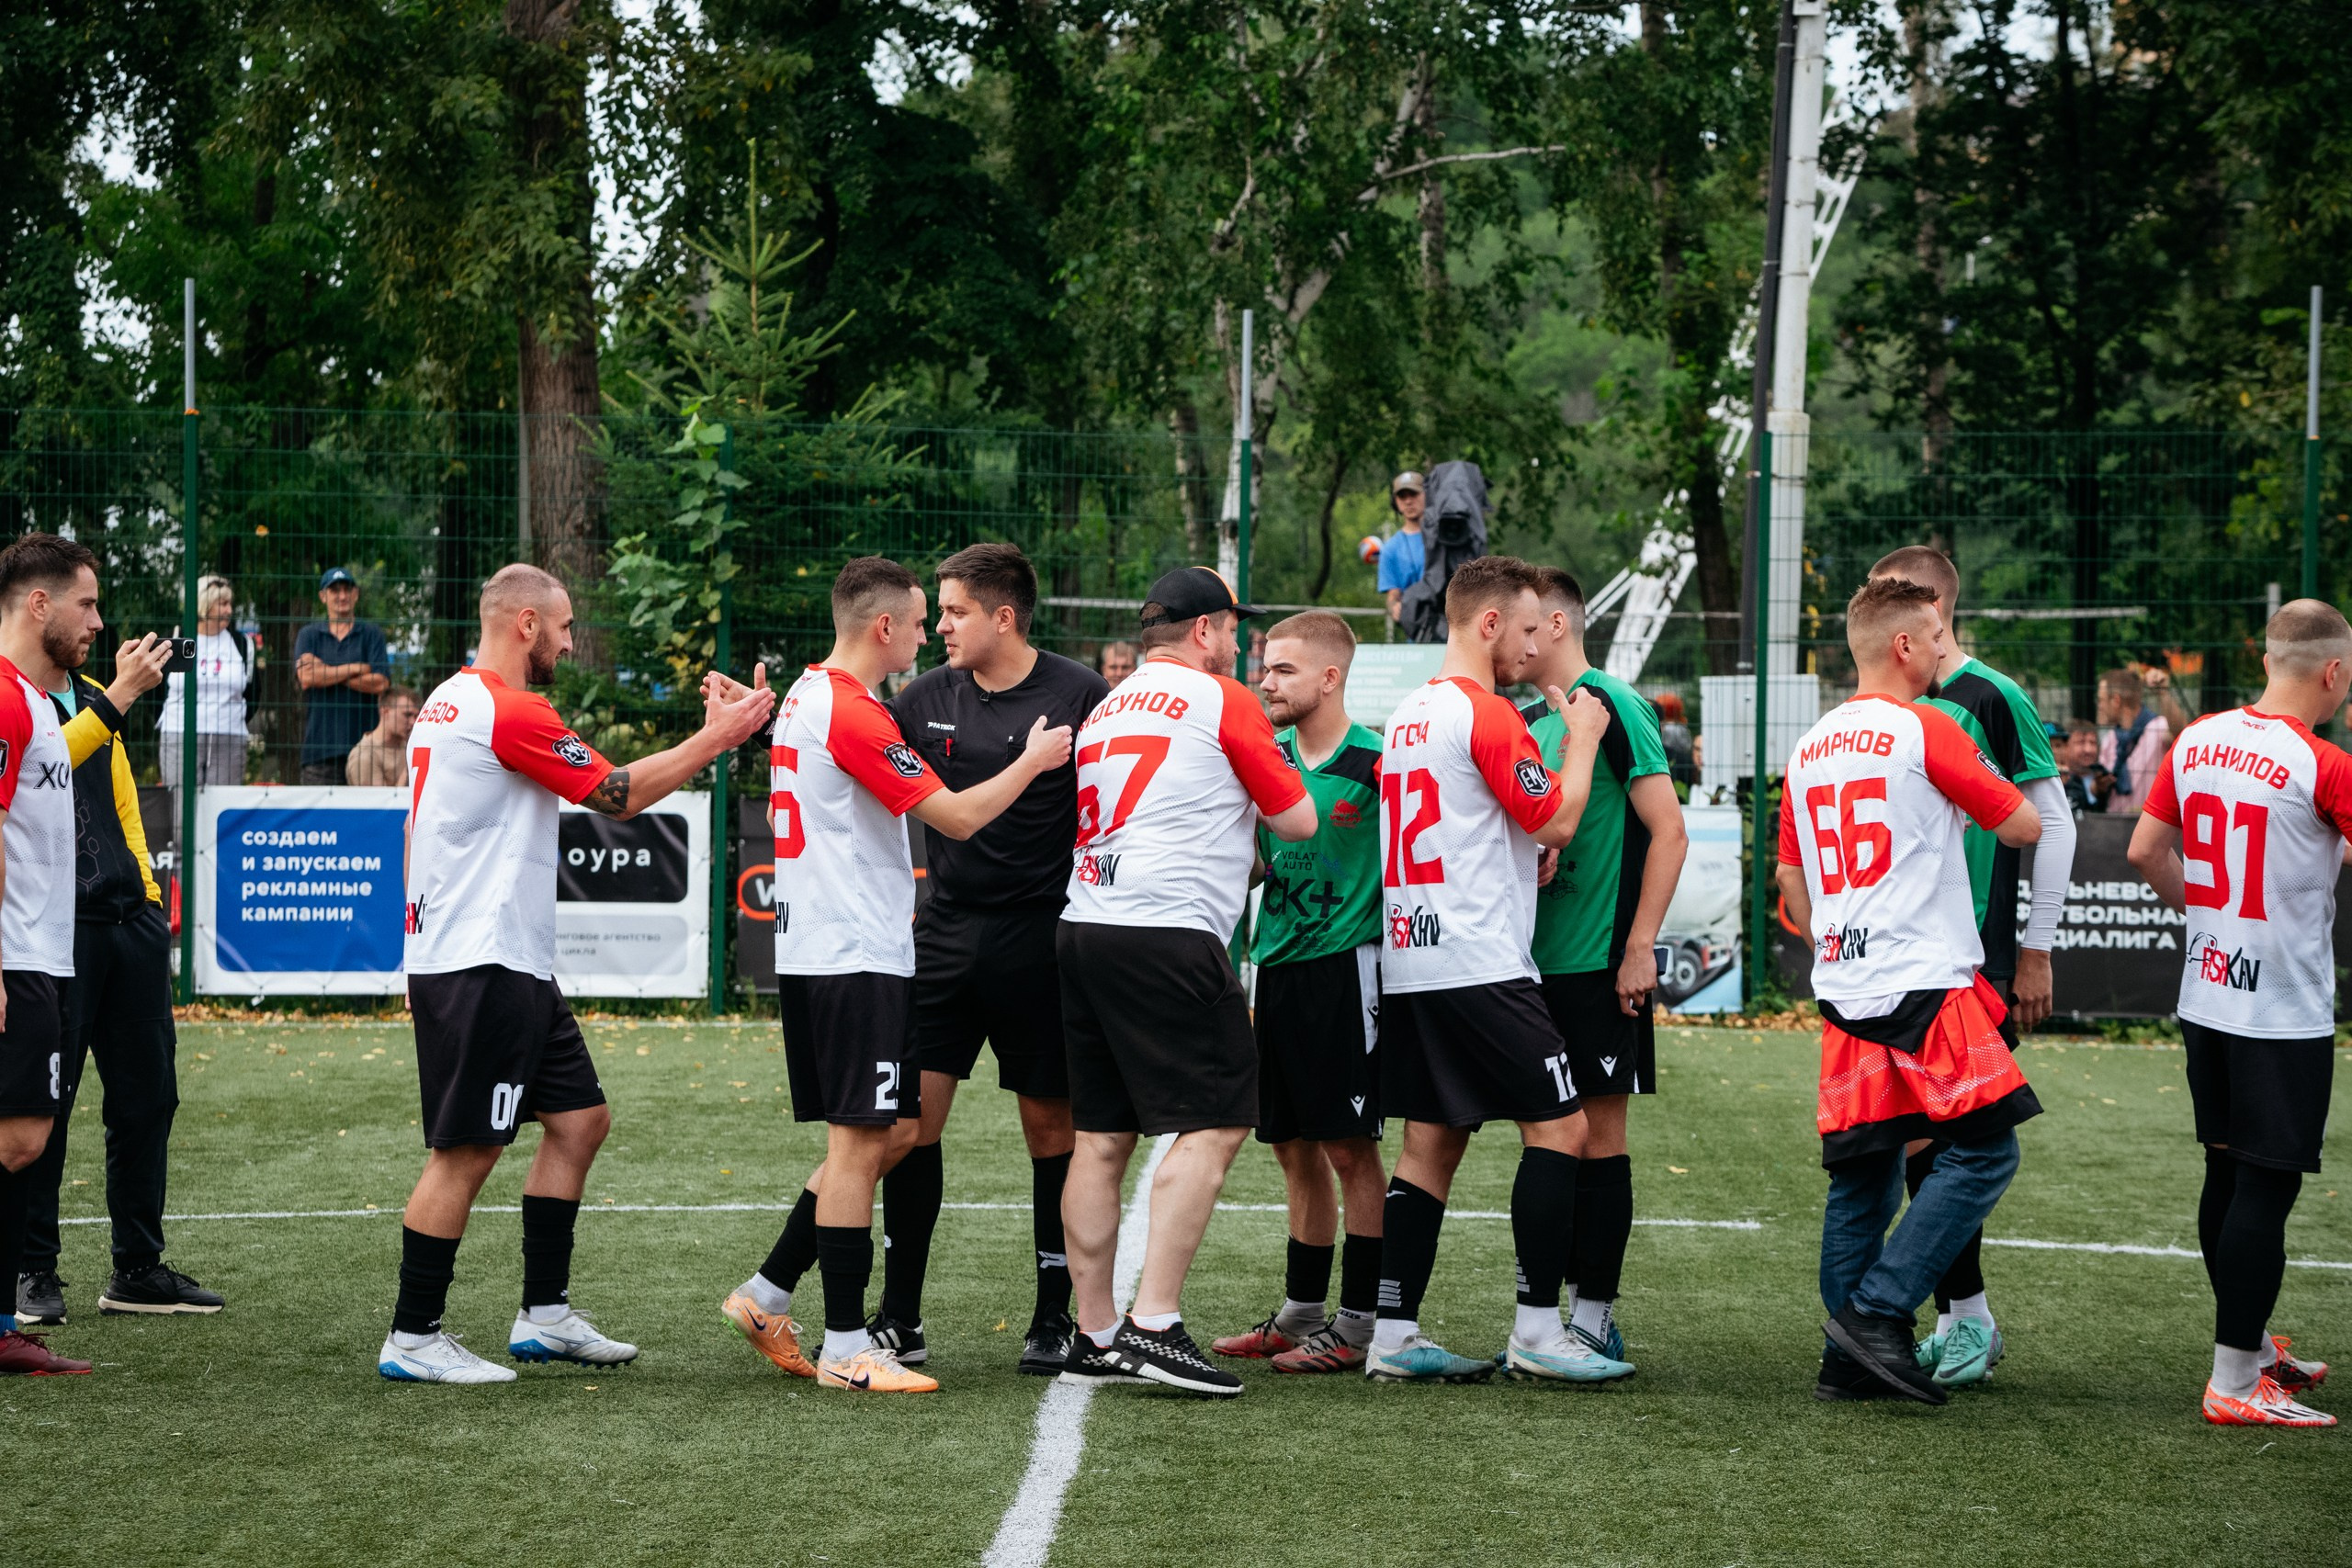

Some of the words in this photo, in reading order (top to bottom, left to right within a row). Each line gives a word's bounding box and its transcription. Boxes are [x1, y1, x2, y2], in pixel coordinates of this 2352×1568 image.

[1801, 729, 1895, 769] МИРНОВ
[2183, 743, 2290, 790] ДАНИЛОВ
[242, 830, 338, 848] создаем
[1380, 768, 1444, 888] 12
[1806, 777, 1893, 896] 66
[242, 856, 256, 871] и
[262, 856, 381, 875] запускаем
[1282, 862, 1313, 871] AUTO
[2183, 792, 2269, 921] 91
[242, 881, 373, 901] рекламные
[242, 906, 354, 921] кампании
